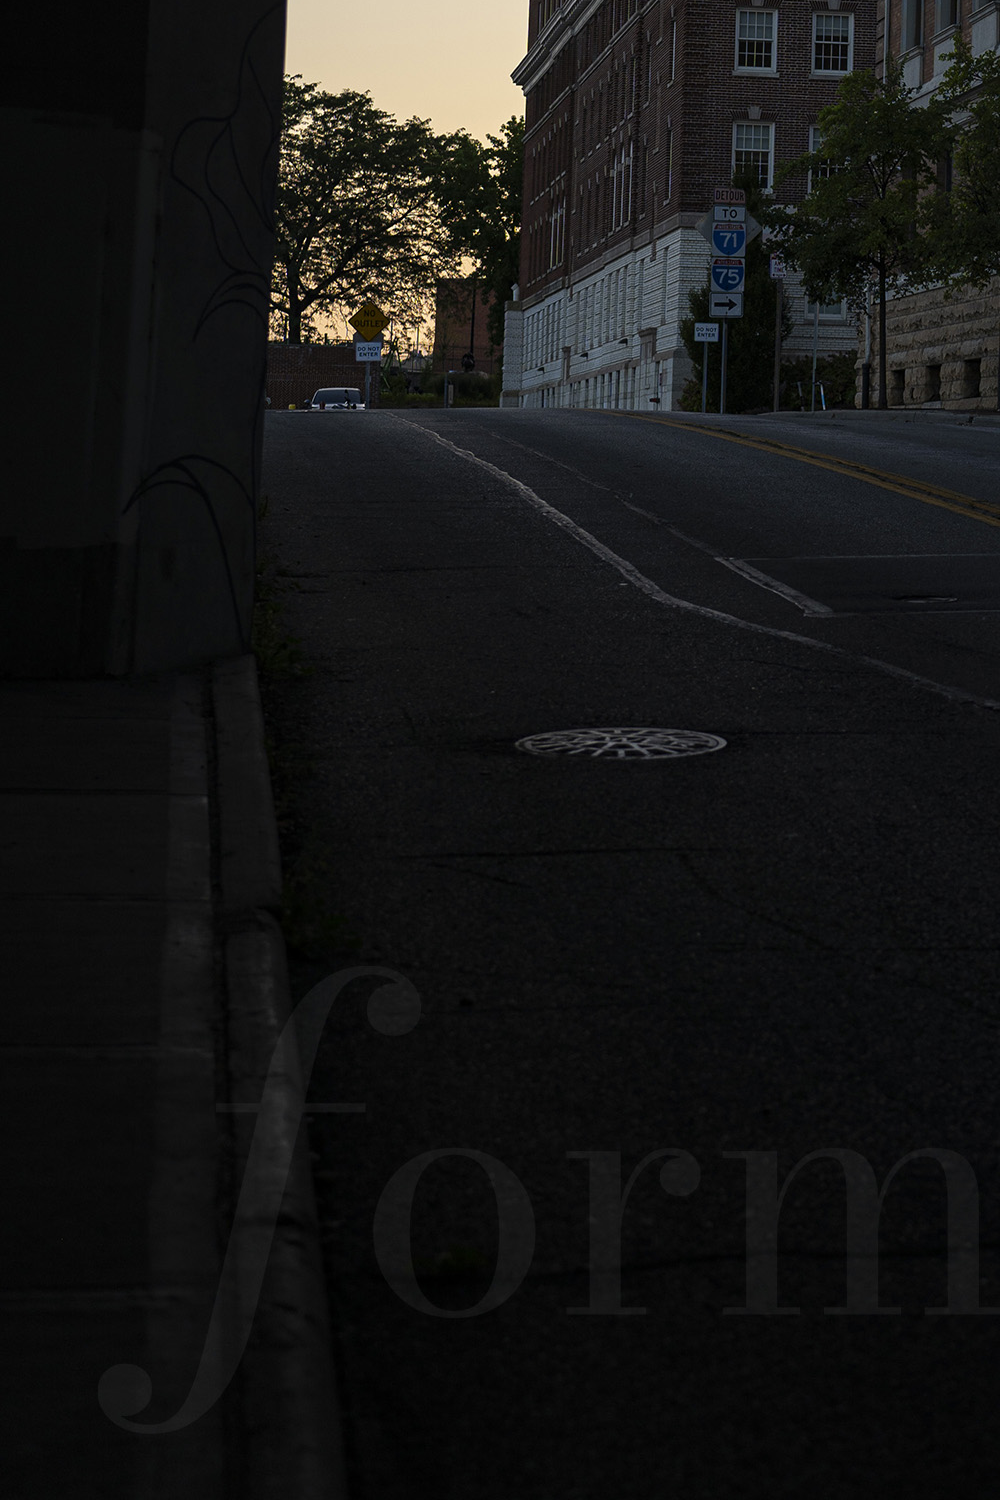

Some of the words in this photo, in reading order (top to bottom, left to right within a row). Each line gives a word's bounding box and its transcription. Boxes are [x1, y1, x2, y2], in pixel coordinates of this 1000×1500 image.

[715, 190, 745, 201] DETOUR
[722, 208, 738, 219] TO
[719, 232, 738, 248] 71
[715, 268, 740, 285] 75
[354, 320, 386, 328] OUTLET
